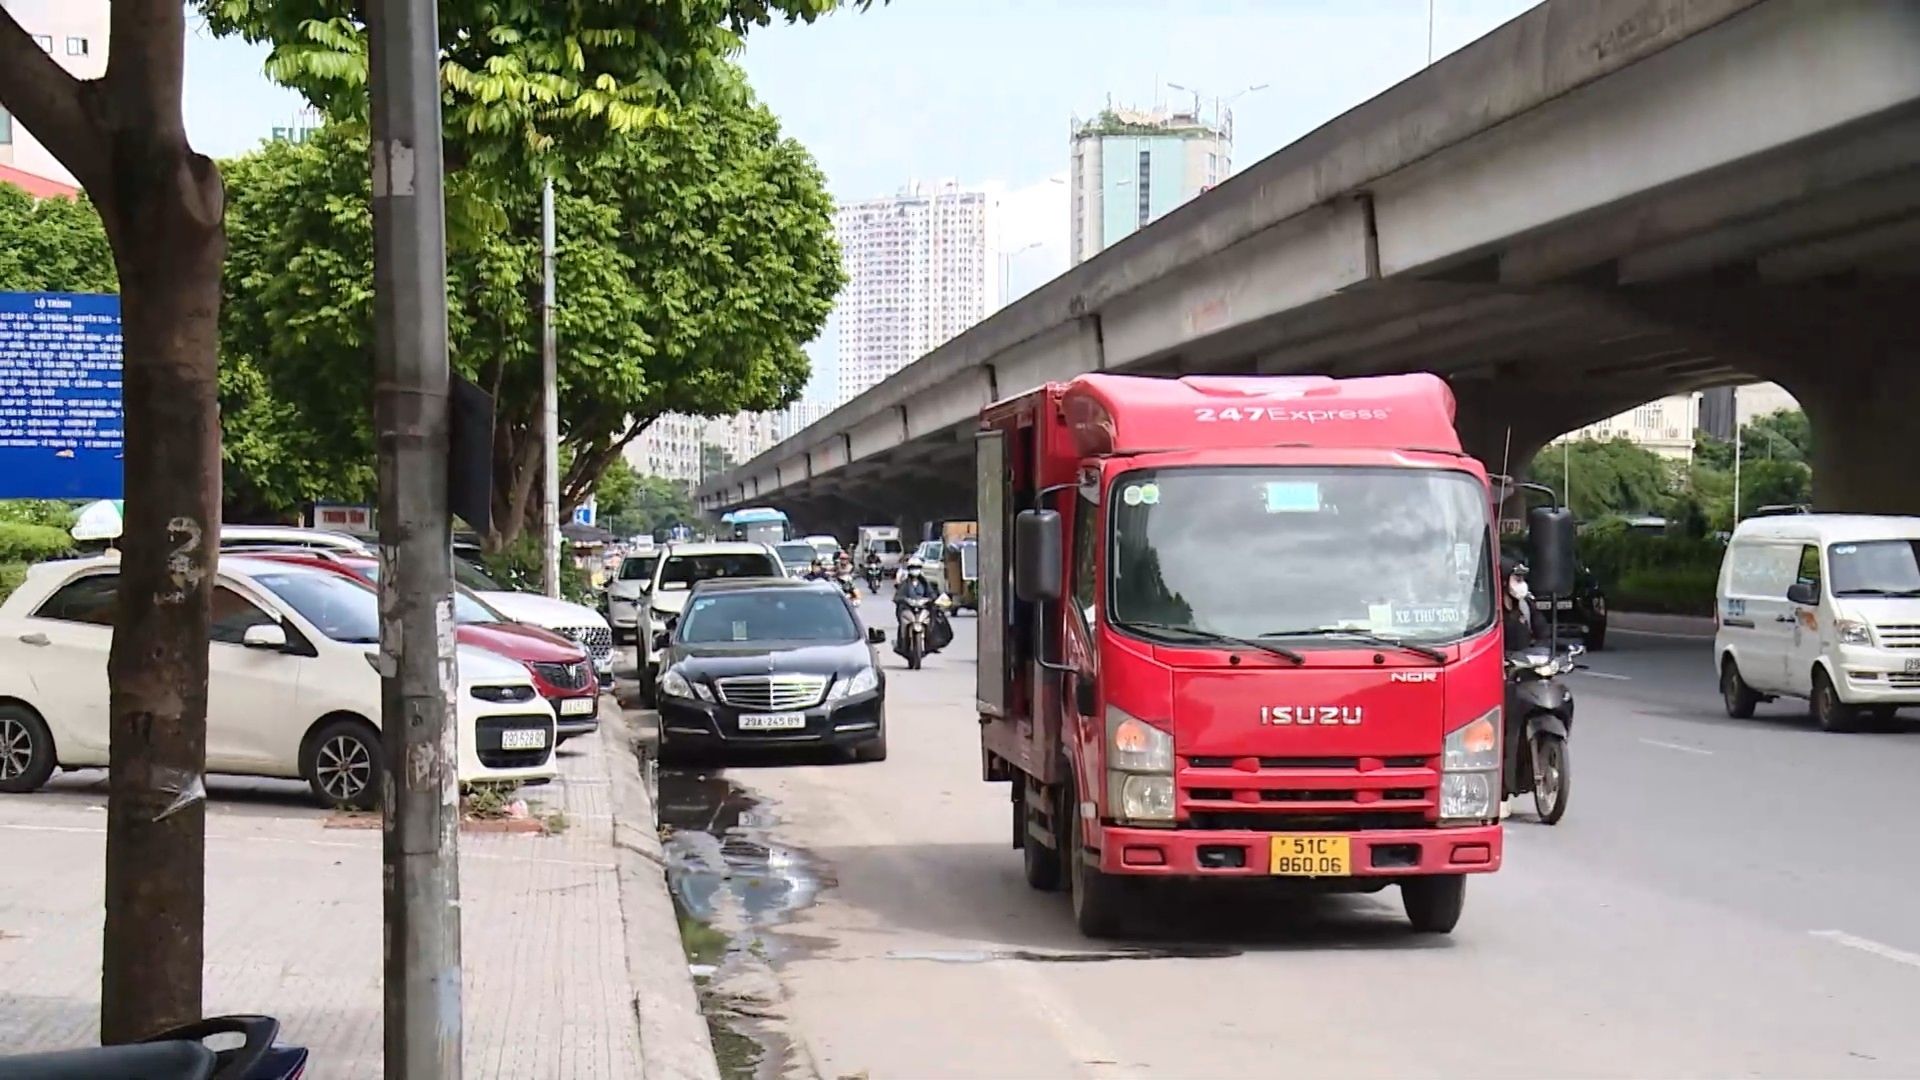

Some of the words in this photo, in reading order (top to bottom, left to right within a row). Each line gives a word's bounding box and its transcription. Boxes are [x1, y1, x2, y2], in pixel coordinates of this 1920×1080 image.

[1260, 705, 1364, 724] ISUZU
[1294, 839, 1327, 854] 51C
[1280, 857, 1342, 872] 860.06
